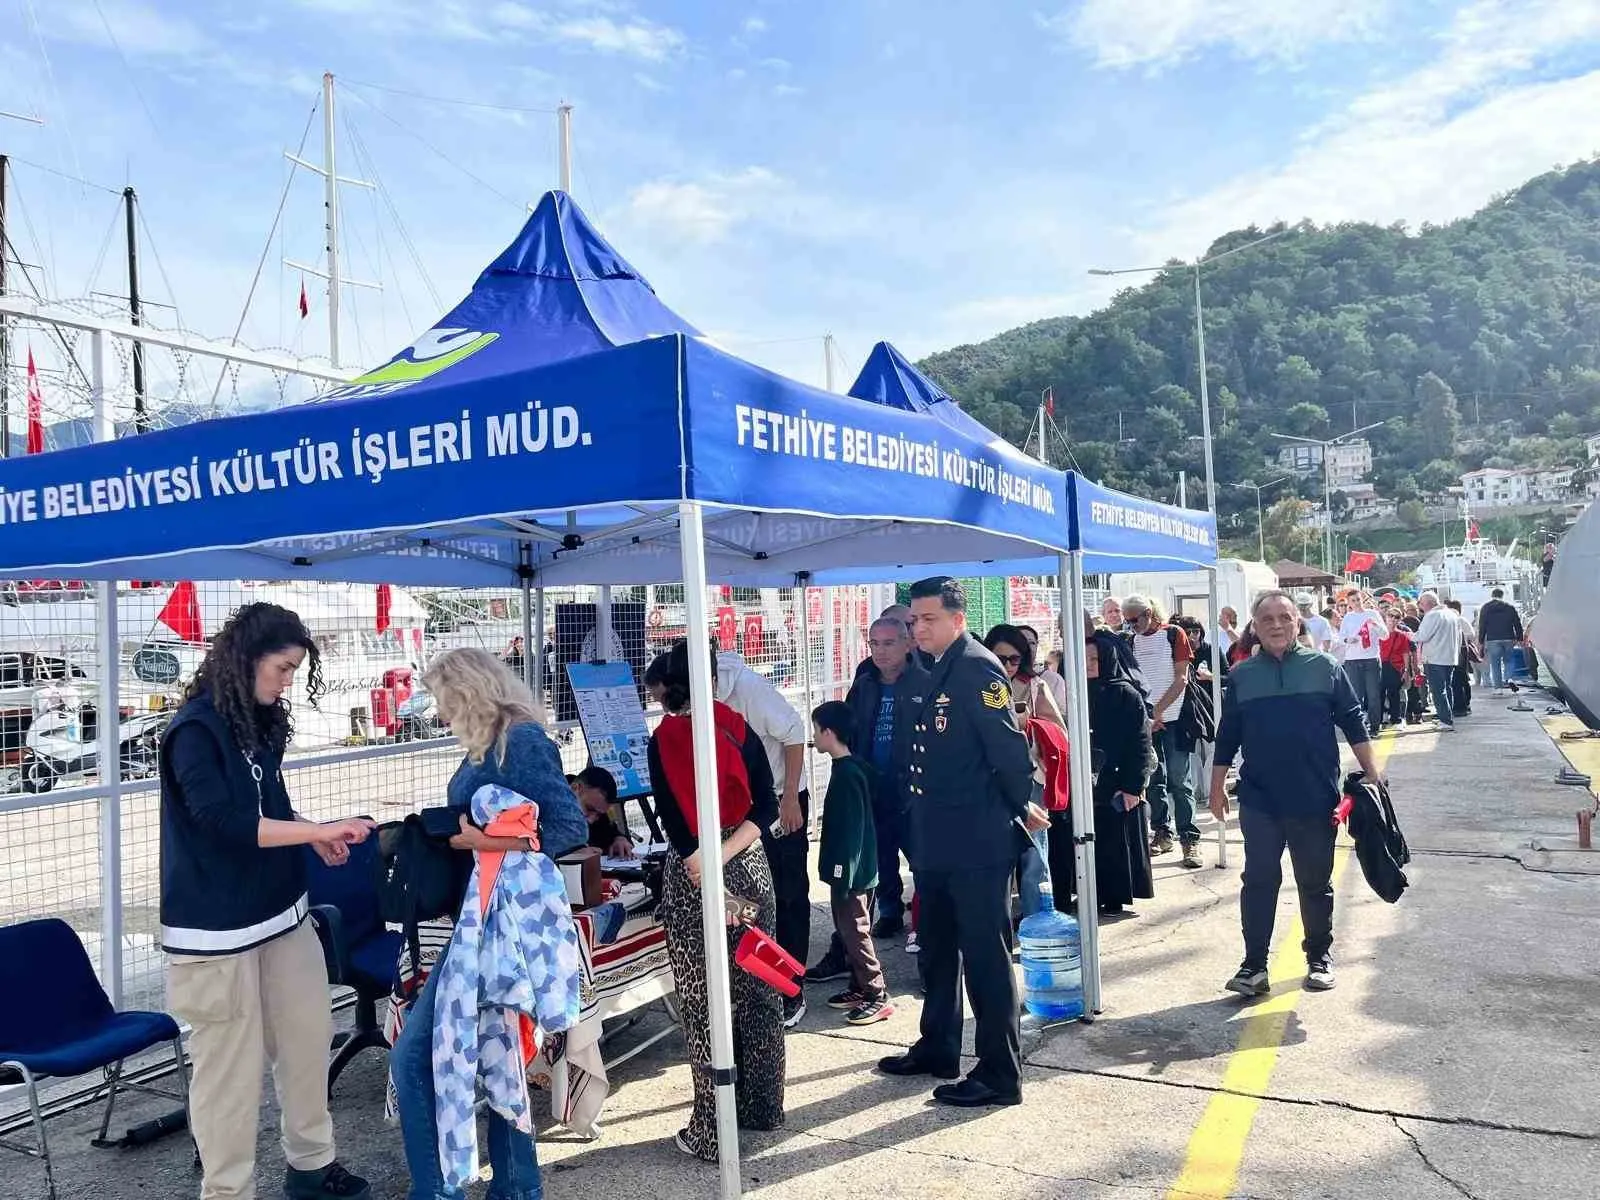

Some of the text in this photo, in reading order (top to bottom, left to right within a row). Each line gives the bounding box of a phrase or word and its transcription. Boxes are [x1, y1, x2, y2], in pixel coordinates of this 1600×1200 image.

[43, 457, 201, 519] BELEDİYESİ
[209, 439, 344, 496] KÜLTÜR
[351, 410, 471, 483] İŞLERİ
[486, 400, 592, 457] MÜD.
[735, 404, 1055, 514] FETHİYE BELEDİYESİ KÜLTÜR İŞLERİ MÜD.
